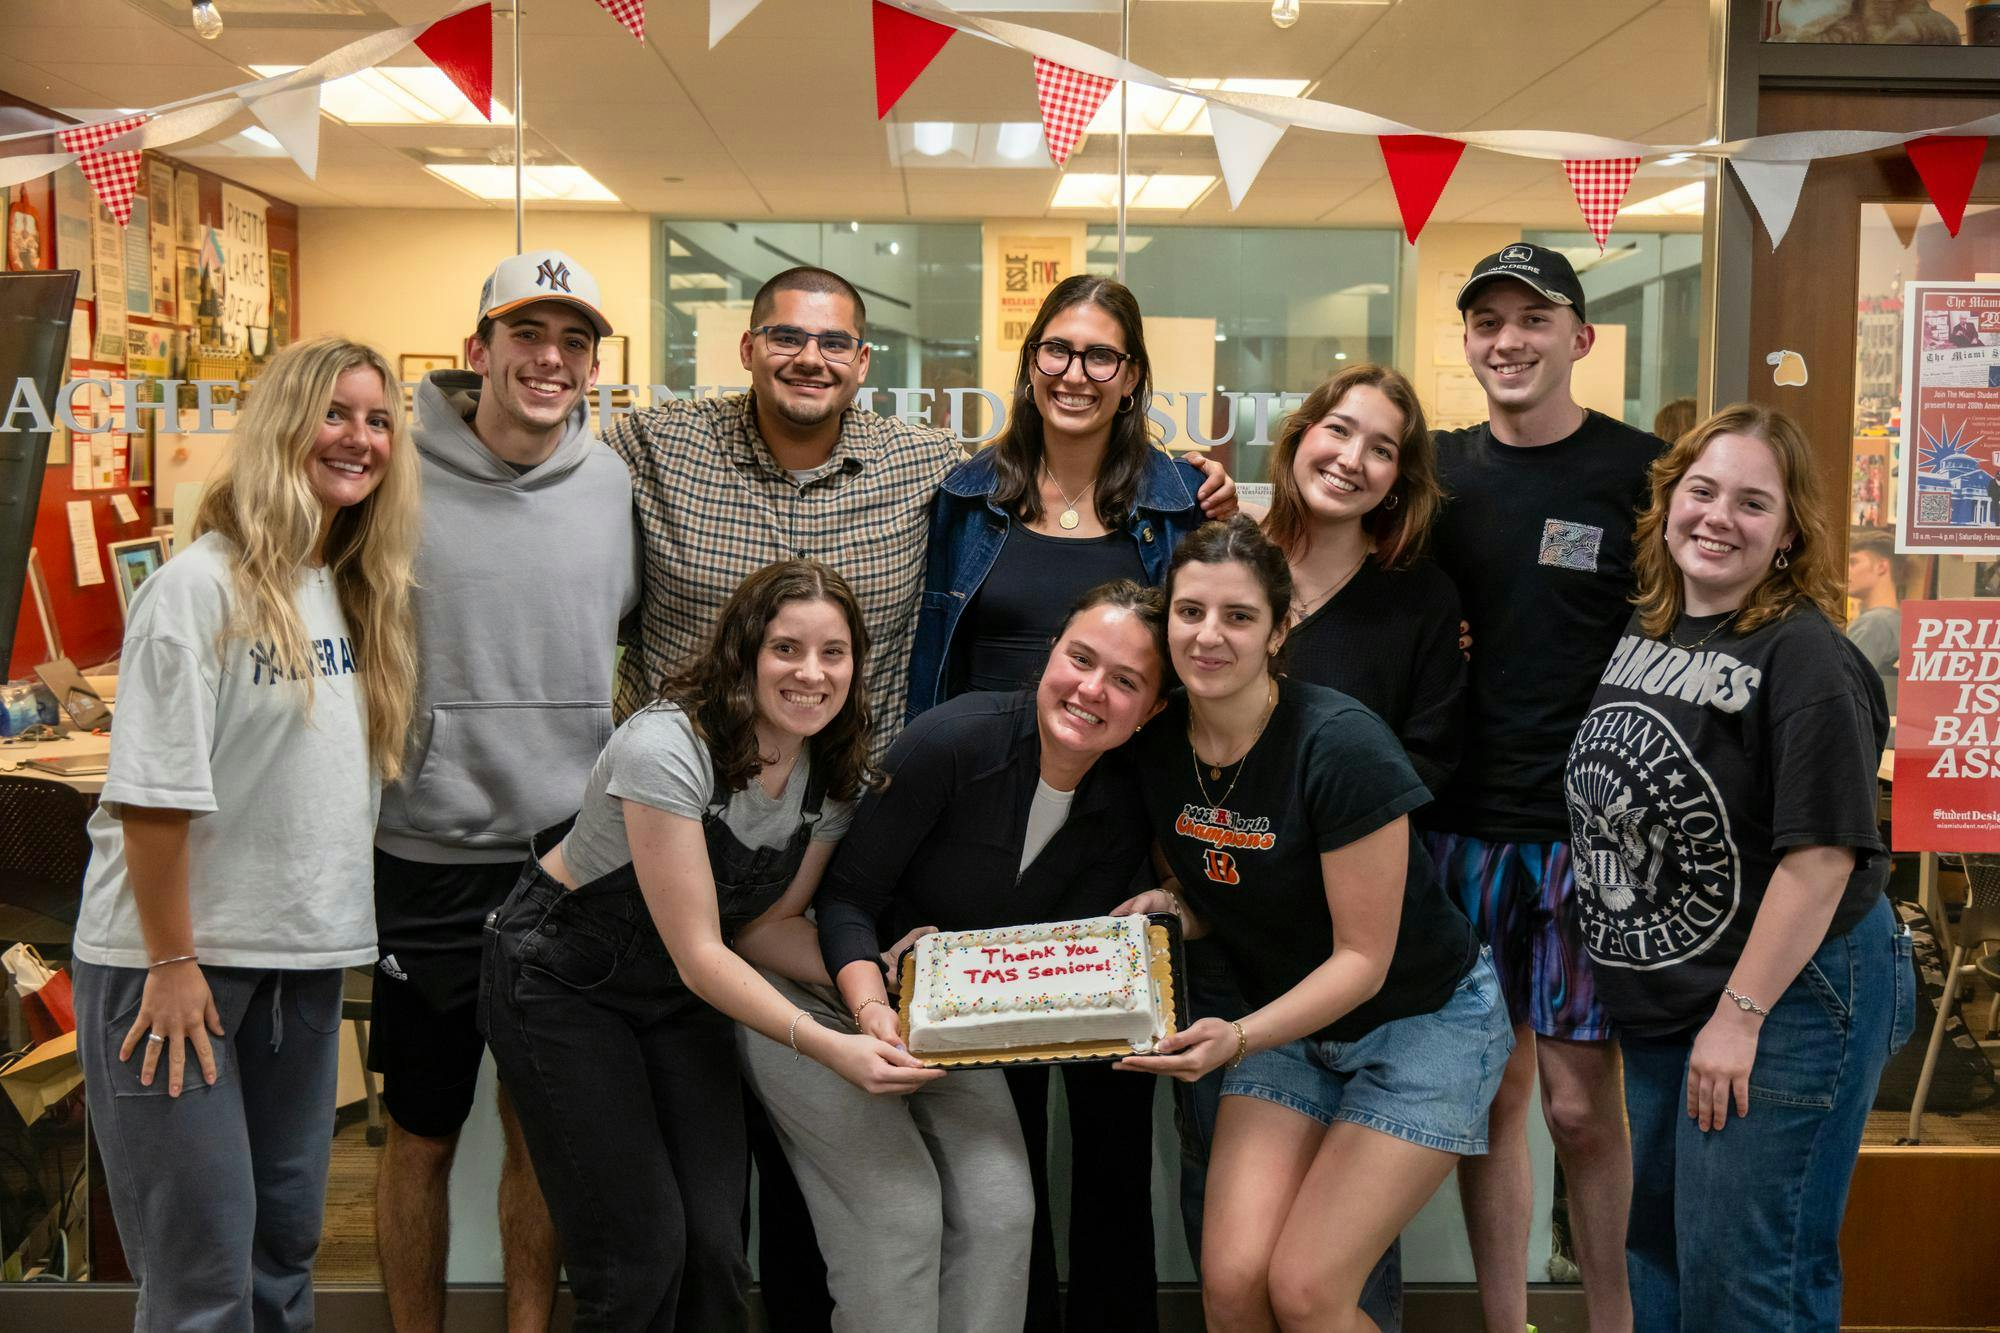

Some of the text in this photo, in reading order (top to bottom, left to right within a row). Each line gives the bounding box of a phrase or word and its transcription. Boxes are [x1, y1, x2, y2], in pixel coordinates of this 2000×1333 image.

[1508, 264, 1541, 275] DEERE
[1946, 296, 1965, 309] The
[1926, 353, 1944, 362] The
[1952, 349, 1985, 361] Miami
[1977, 391, 1999, 399] Student
[1953, 683, 2000, 714] IS
[1230, 811, 1270, 832] North
[1933, 808, 1971, 820] Student
[1175, 812, 1276, 850] Champions
[1669, 791, 1730, 881] JOEY
[981, 944, 1099, 964] Thank You
[963, 967, 1019, 984] TMS
